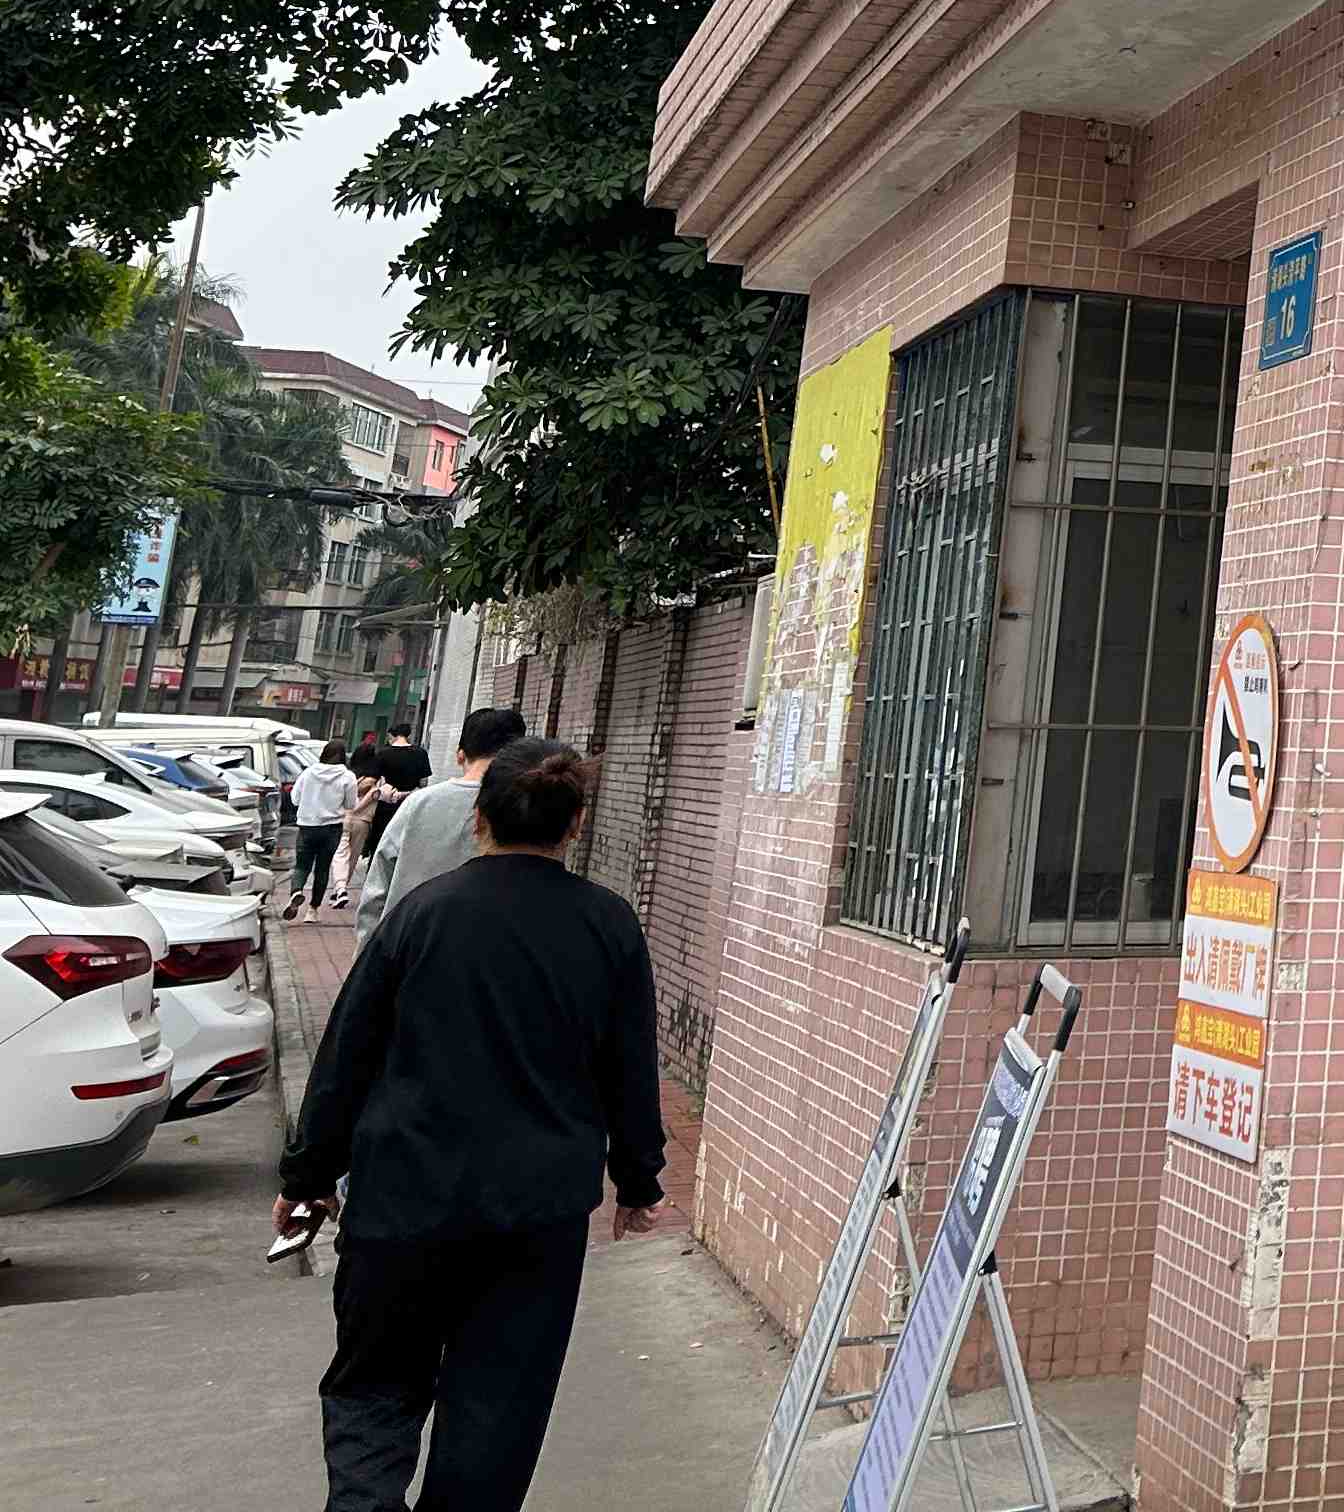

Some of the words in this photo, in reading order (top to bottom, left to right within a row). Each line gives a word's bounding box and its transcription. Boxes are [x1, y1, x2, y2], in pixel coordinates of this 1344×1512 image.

[1174, 1060, 1254, 1144] 请下车登记
